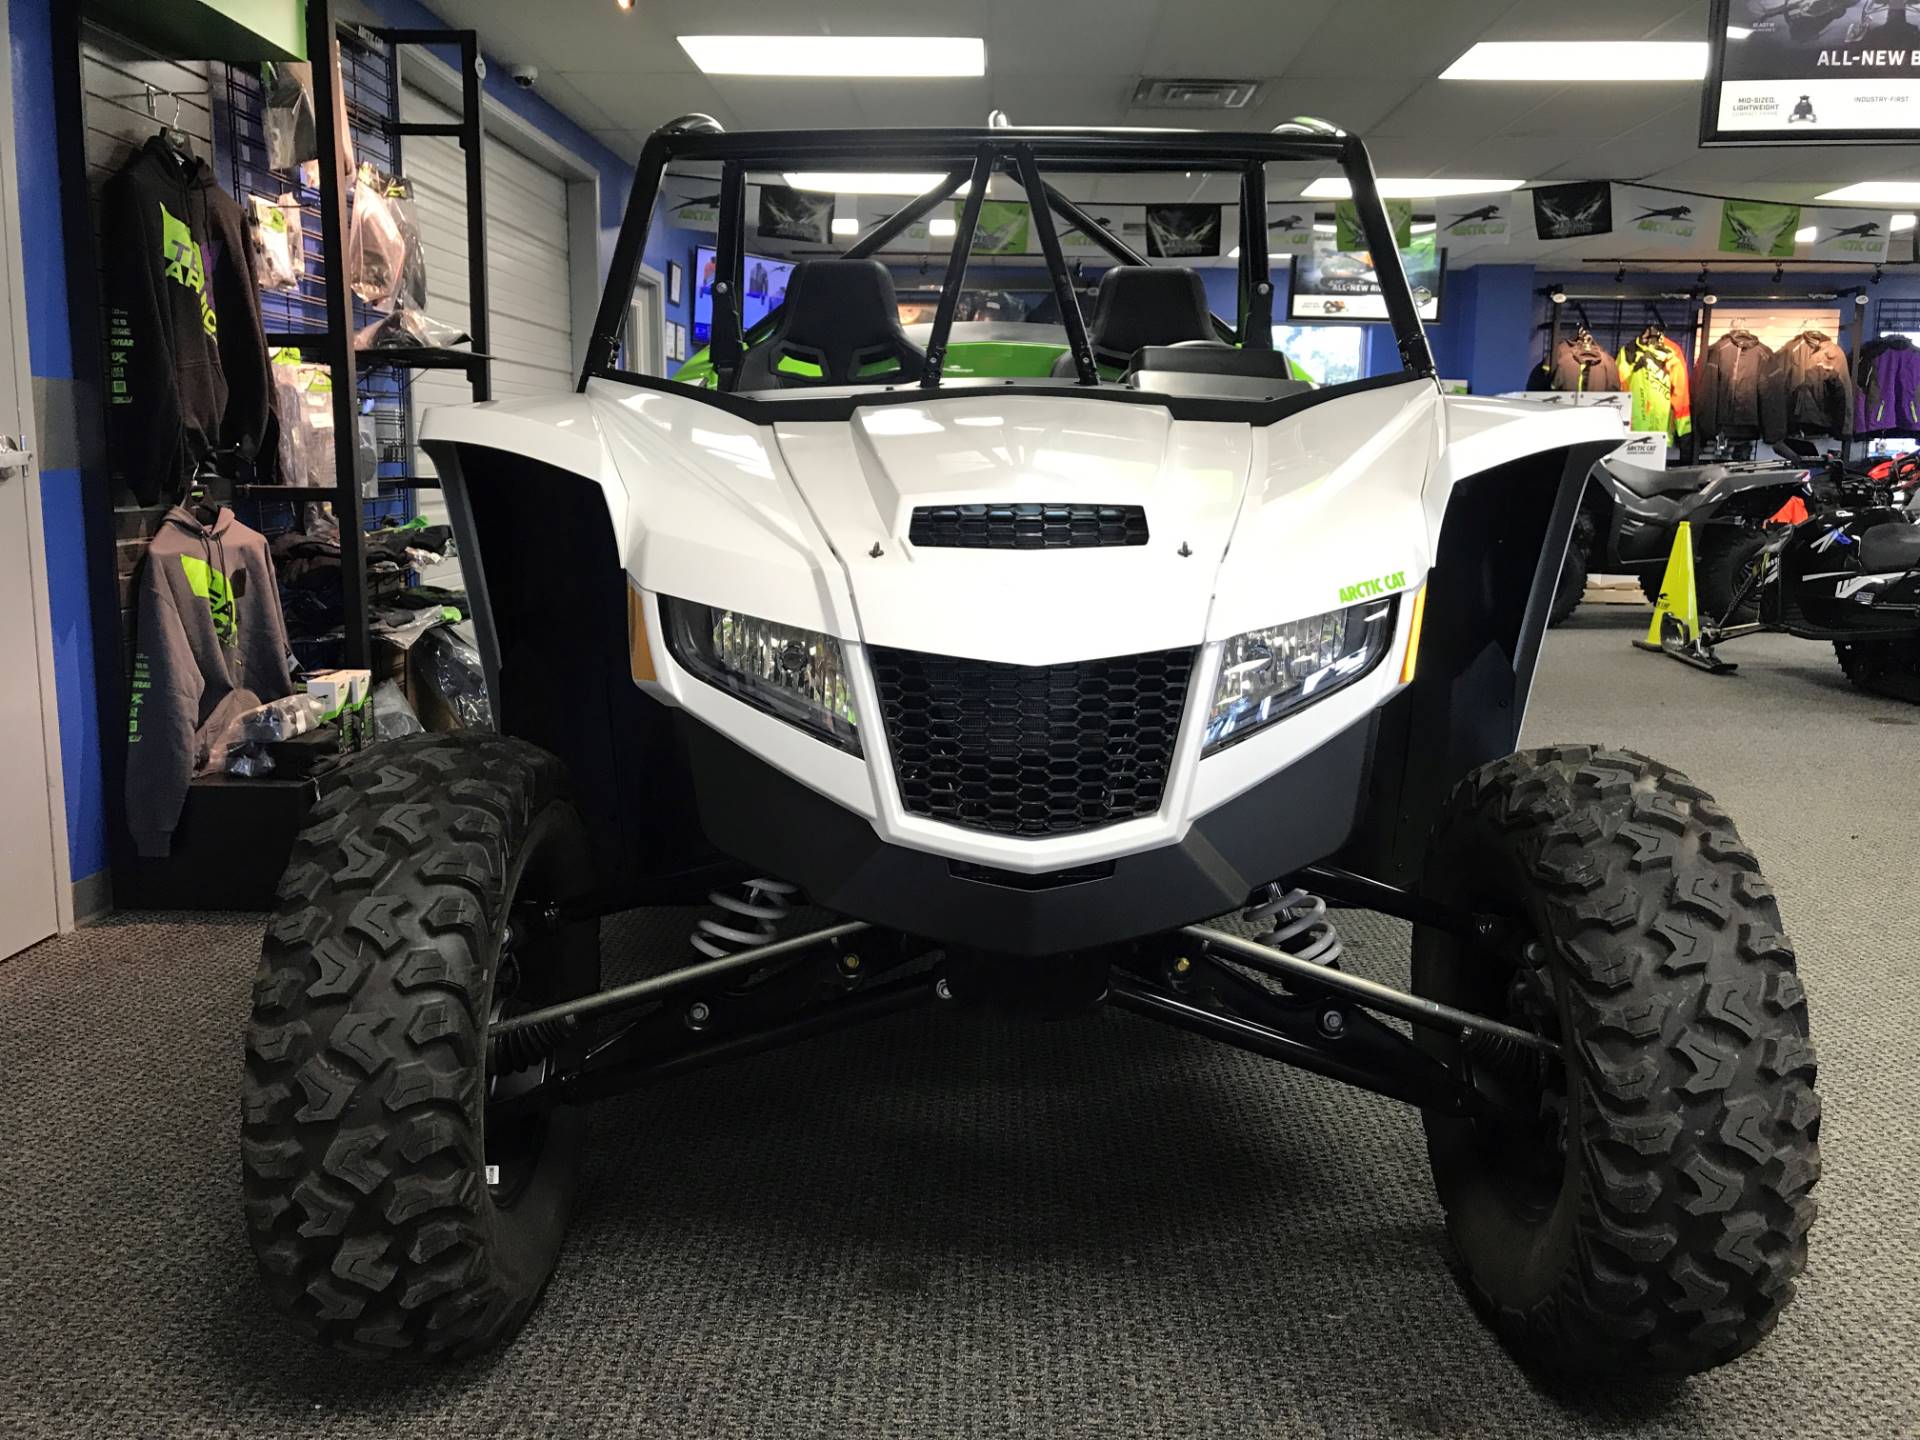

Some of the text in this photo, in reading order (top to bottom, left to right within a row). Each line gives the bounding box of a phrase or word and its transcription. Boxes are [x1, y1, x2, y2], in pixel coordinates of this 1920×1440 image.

[1817, 50, 1905, 66] ALL-NEW
[1732, 103, 1779, 111] LIGHTWEIGHT
[1332, 284, 1368, 292] ALL-NEW
[1339, 571, 1406, 604] ARCTIC CAT
